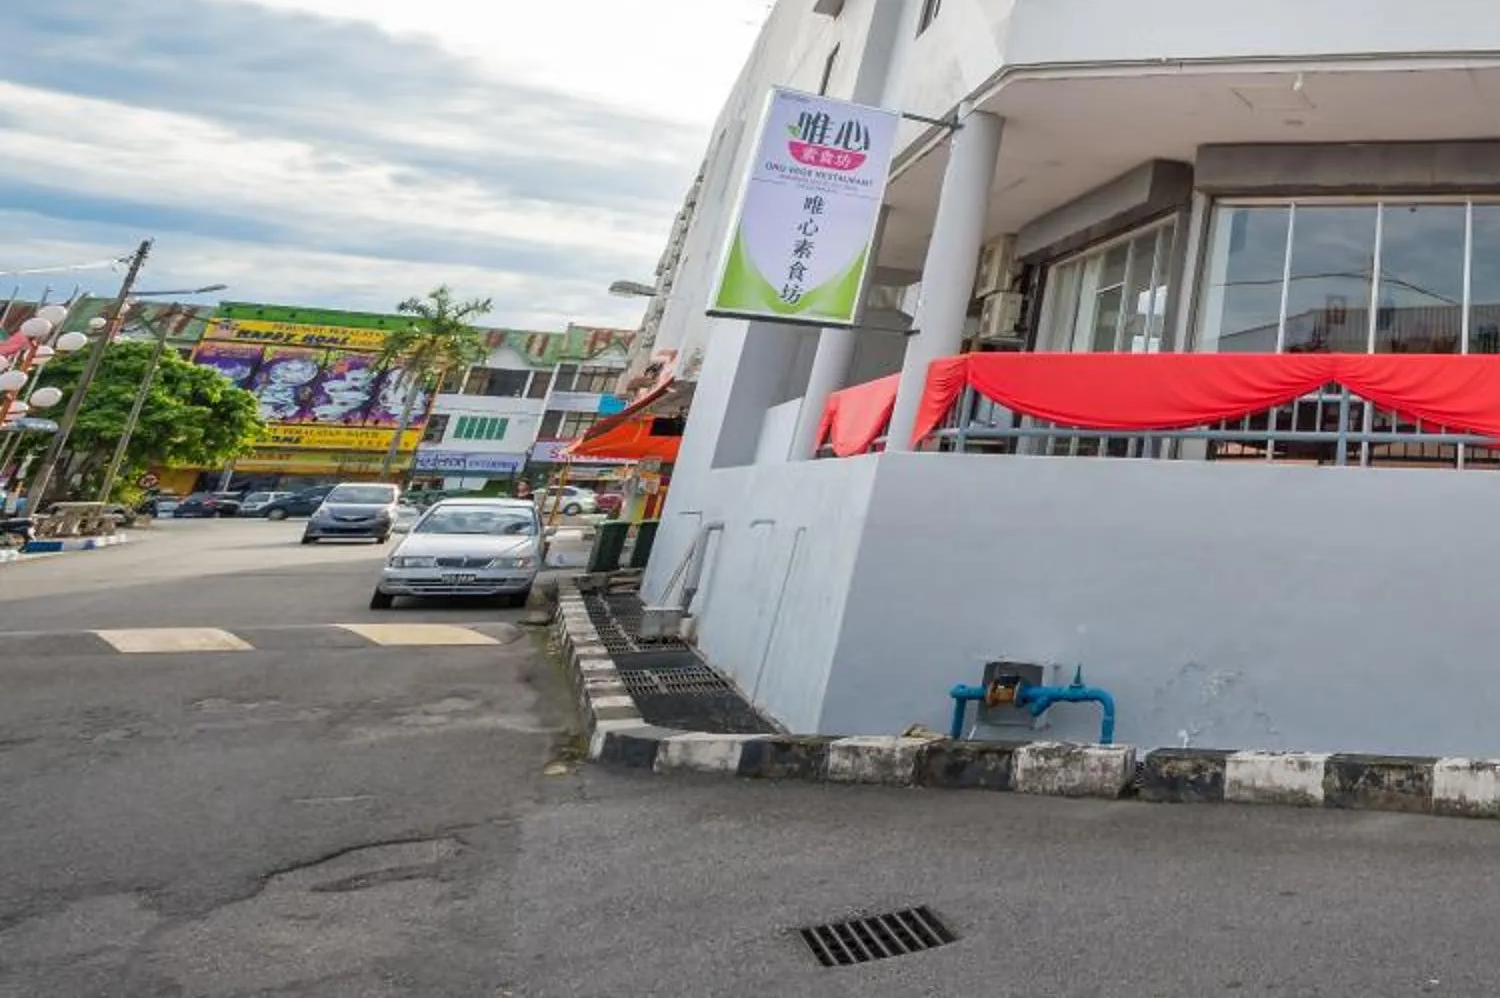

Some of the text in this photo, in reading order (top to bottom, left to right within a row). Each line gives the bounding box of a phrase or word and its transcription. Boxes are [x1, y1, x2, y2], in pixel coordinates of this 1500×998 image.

[799, 110, 871, 152] 唯心
[779, 193, 825, 306] 唯心素食坊
